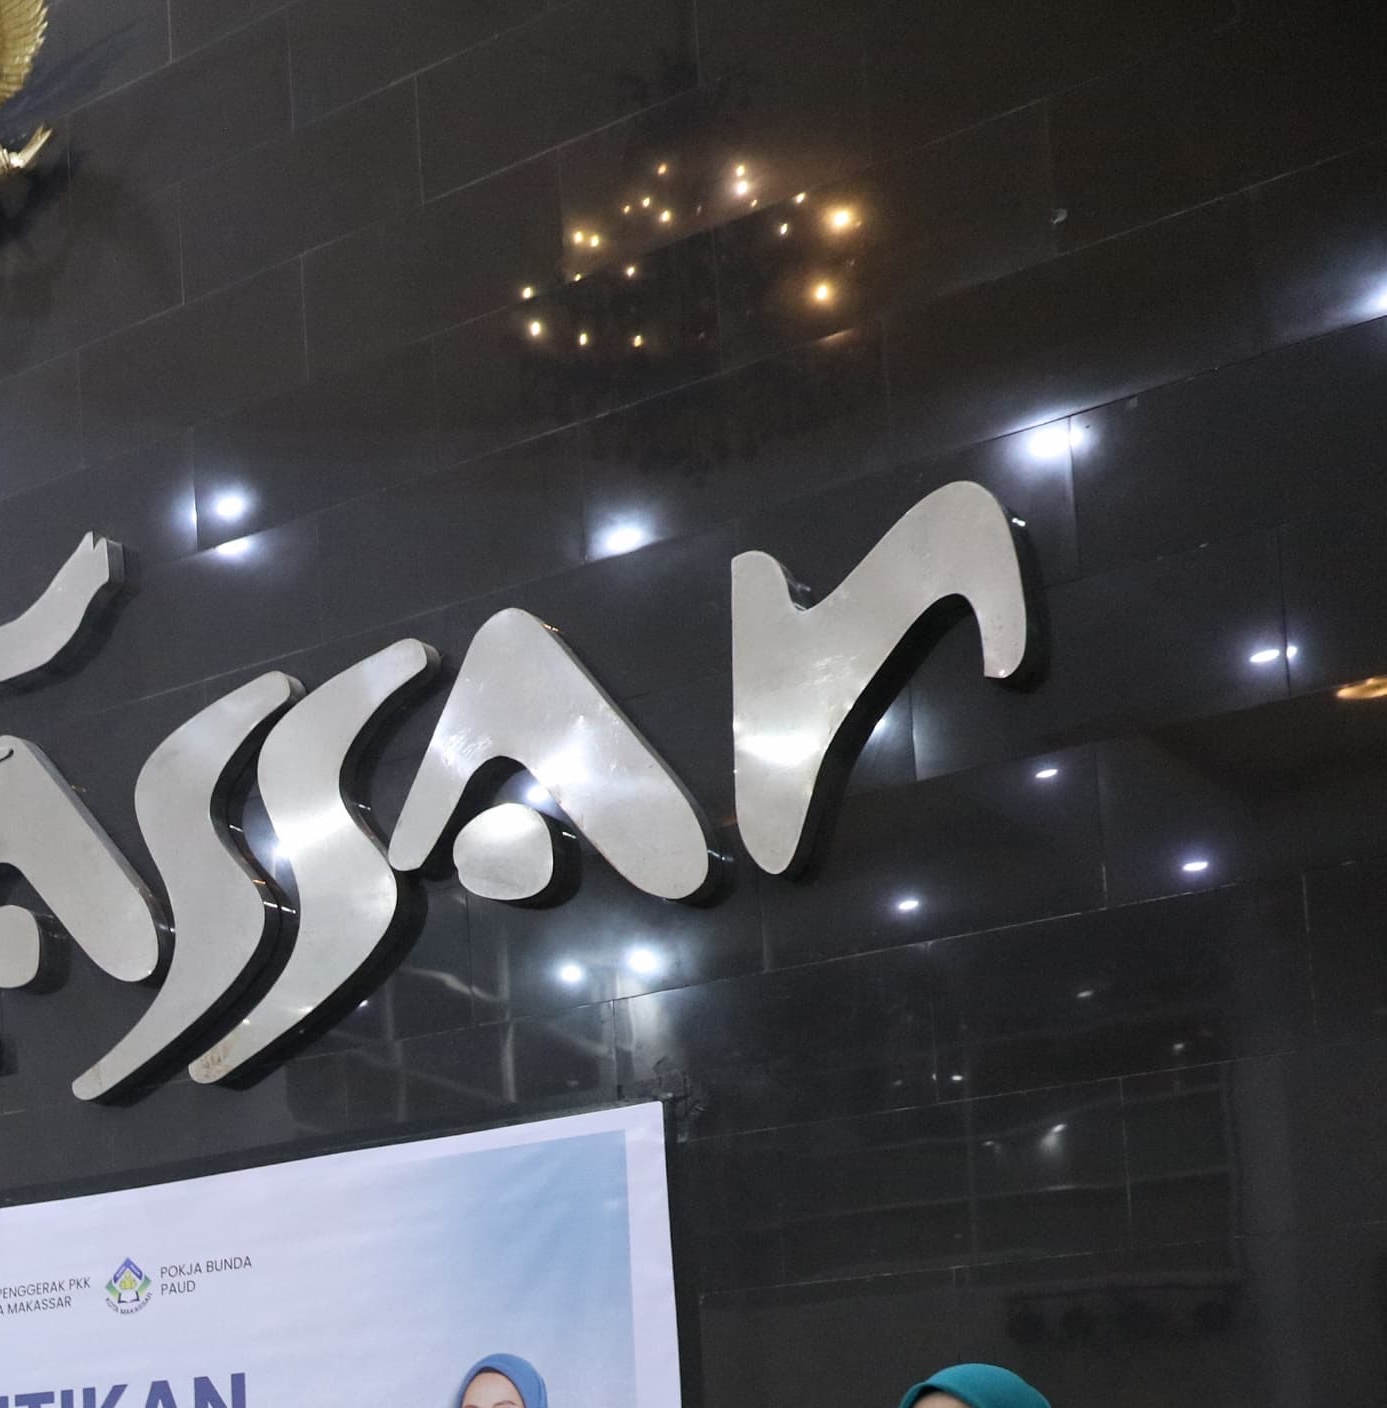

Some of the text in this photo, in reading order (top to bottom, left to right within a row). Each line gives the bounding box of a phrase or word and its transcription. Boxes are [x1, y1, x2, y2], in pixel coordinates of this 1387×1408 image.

[160, 1256, 252, 1279] POKJA BUNDA
[69, 1277, 91, 1290] PKK
[160, 1280, 196, 1296] PAUD
[7, 1295, 72, 1315] MAKASSAR
